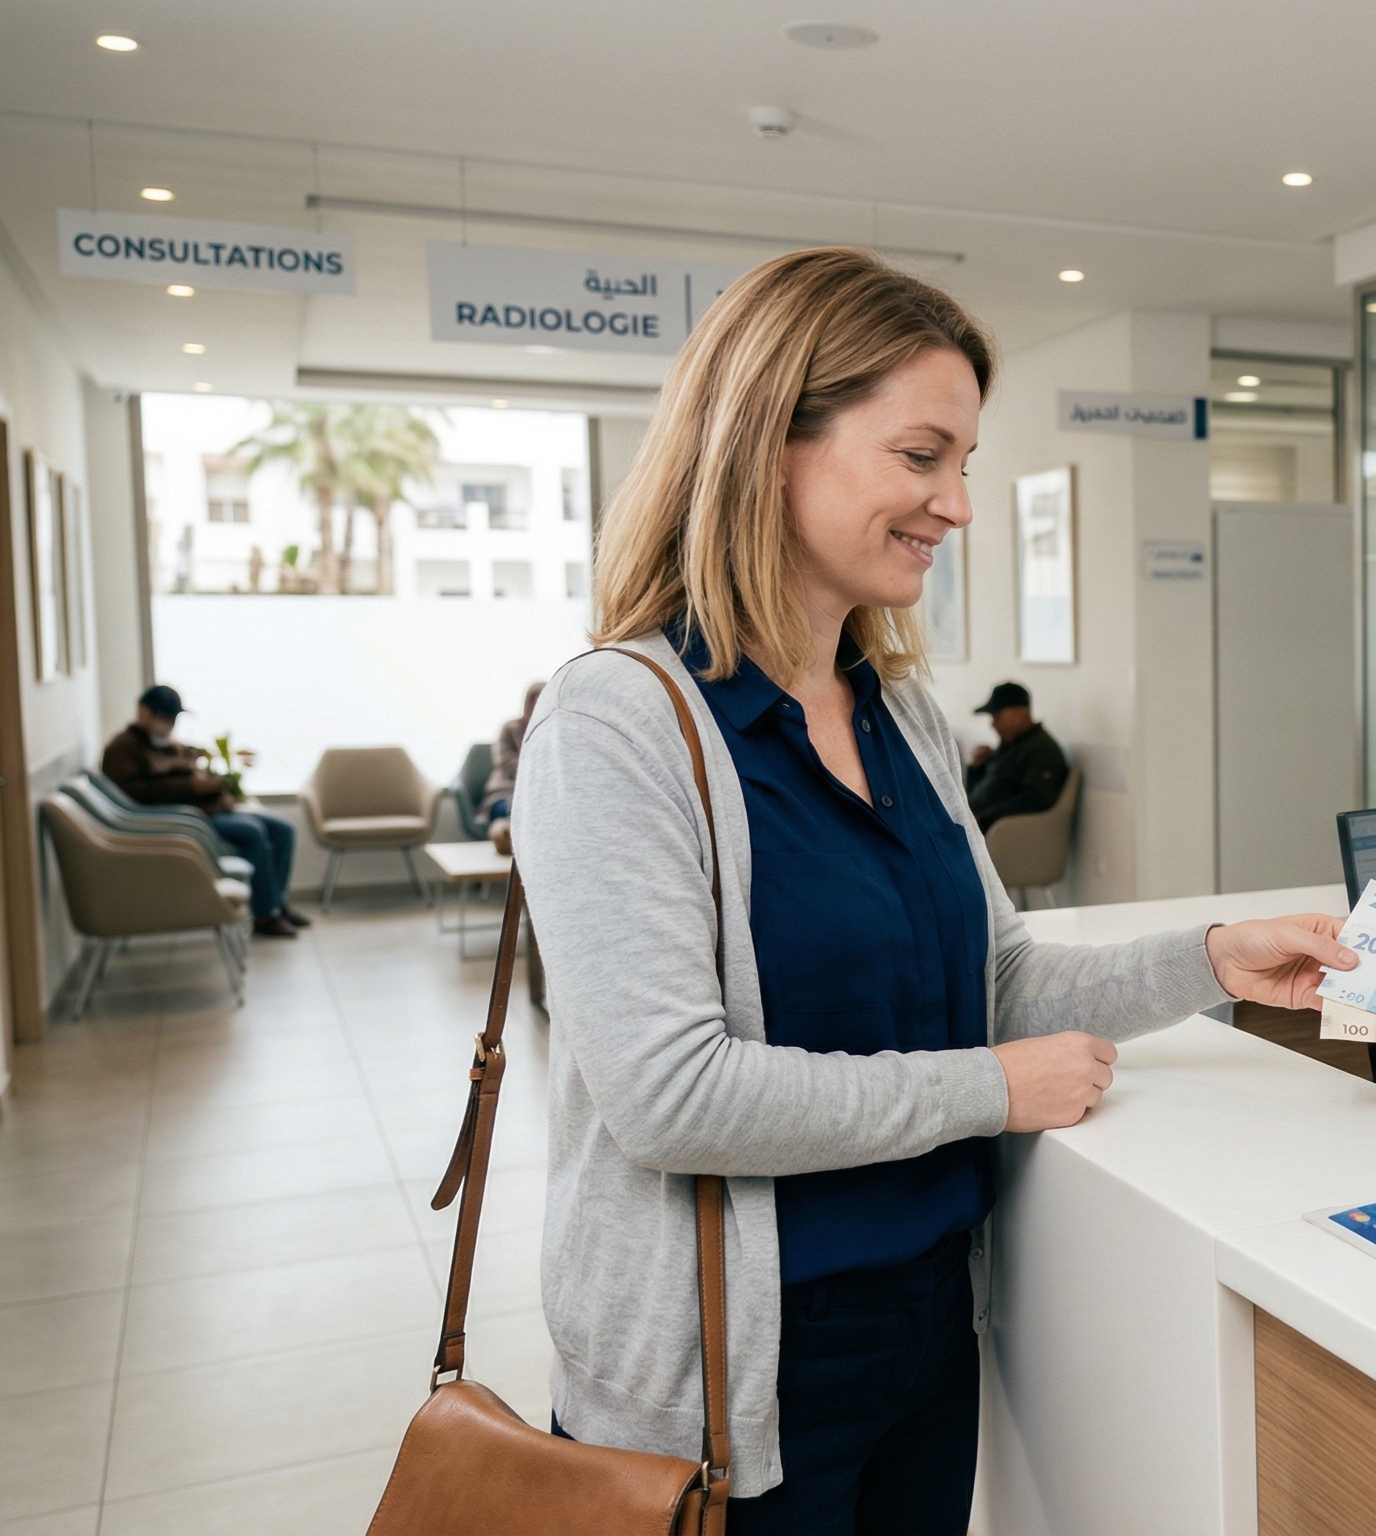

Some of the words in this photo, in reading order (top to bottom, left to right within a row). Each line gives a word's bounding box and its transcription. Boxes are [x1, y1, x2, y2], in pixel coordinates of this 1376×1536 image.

[73, 232, 344, 276] CONSULTATIONS
[455, 301, 660, 338] RADIOLOGIE
[1342, 1023, 1369, 1037] 100
